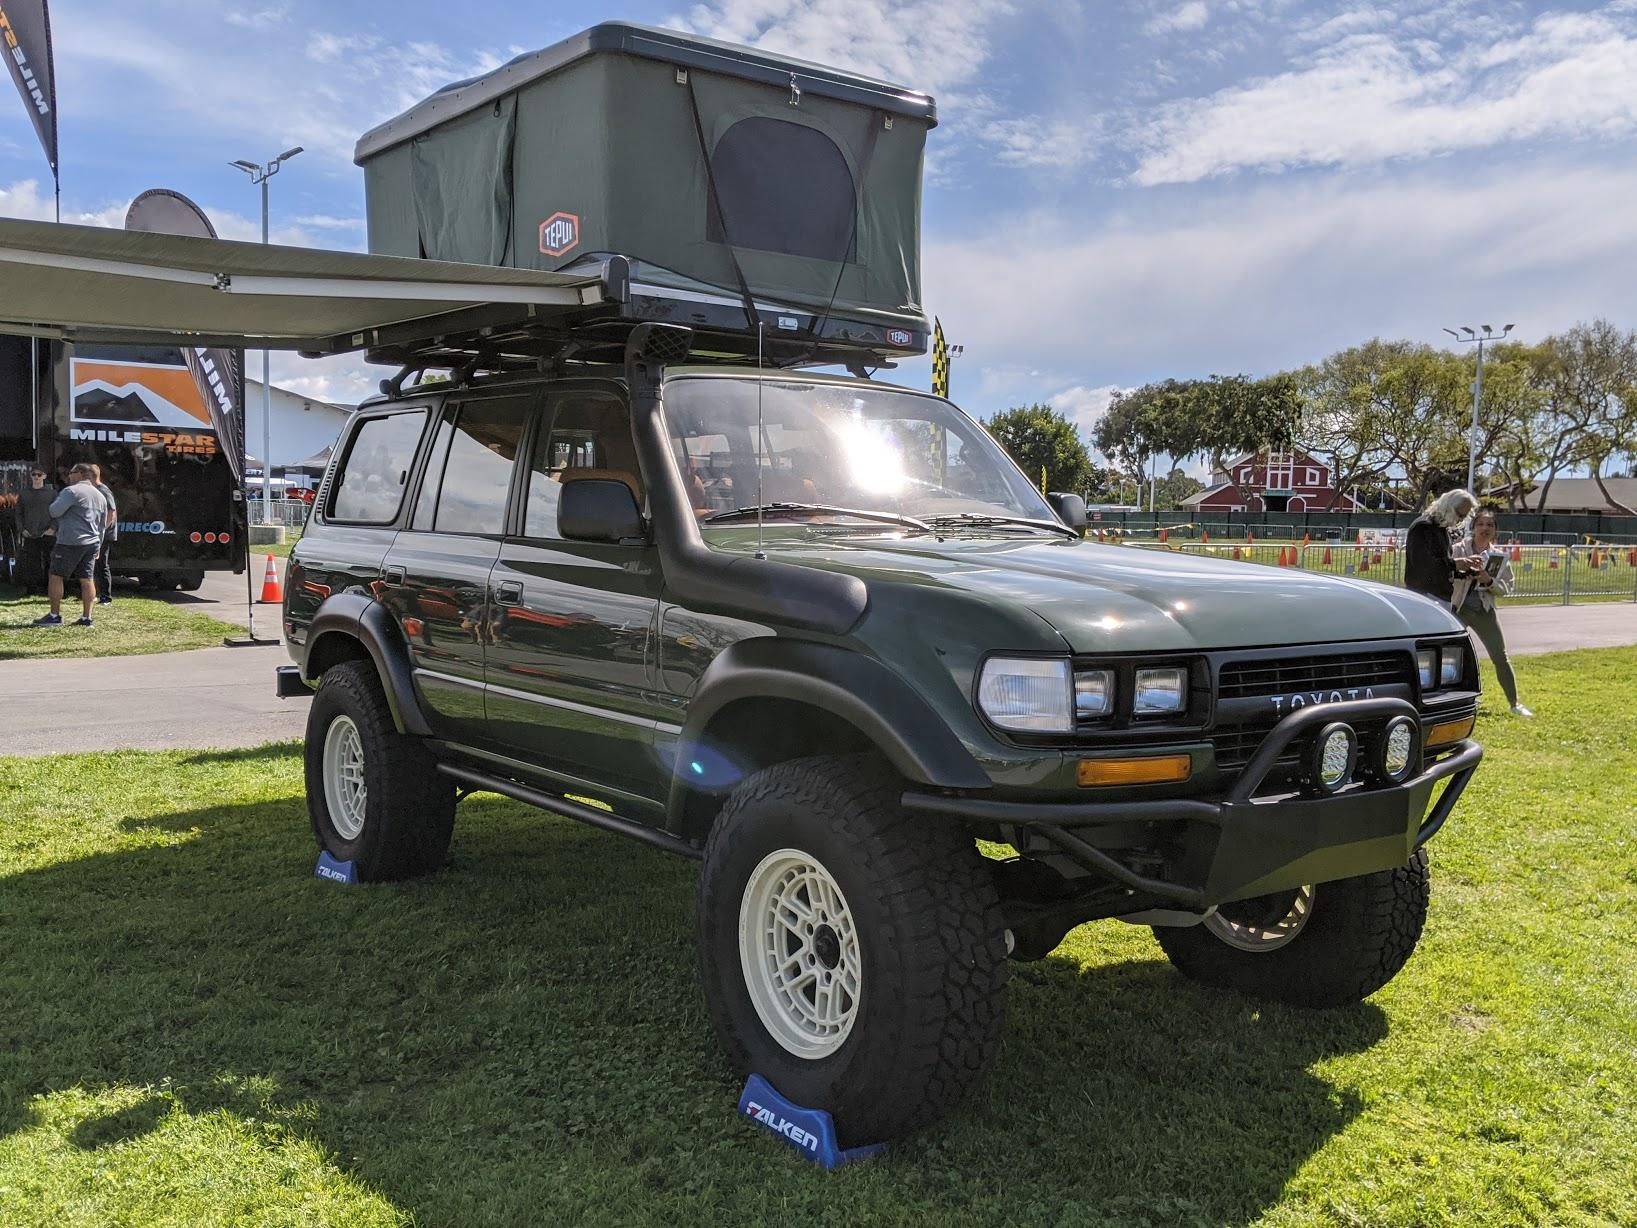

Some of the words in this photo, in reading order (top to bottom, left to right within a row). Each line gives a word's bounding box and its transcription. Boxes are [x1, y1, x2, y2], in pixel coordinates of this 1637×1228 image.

[545, 220, 572, 248] TEPUI
[890, 331, 908, 344] TEPUI
[70, 428, 215, 446] MILESTAR
[165, 445, 216, 454] TIRES
[317, 865, 346, 882] FALKEN
[746, 1101, 818, 1152] FALKEN
